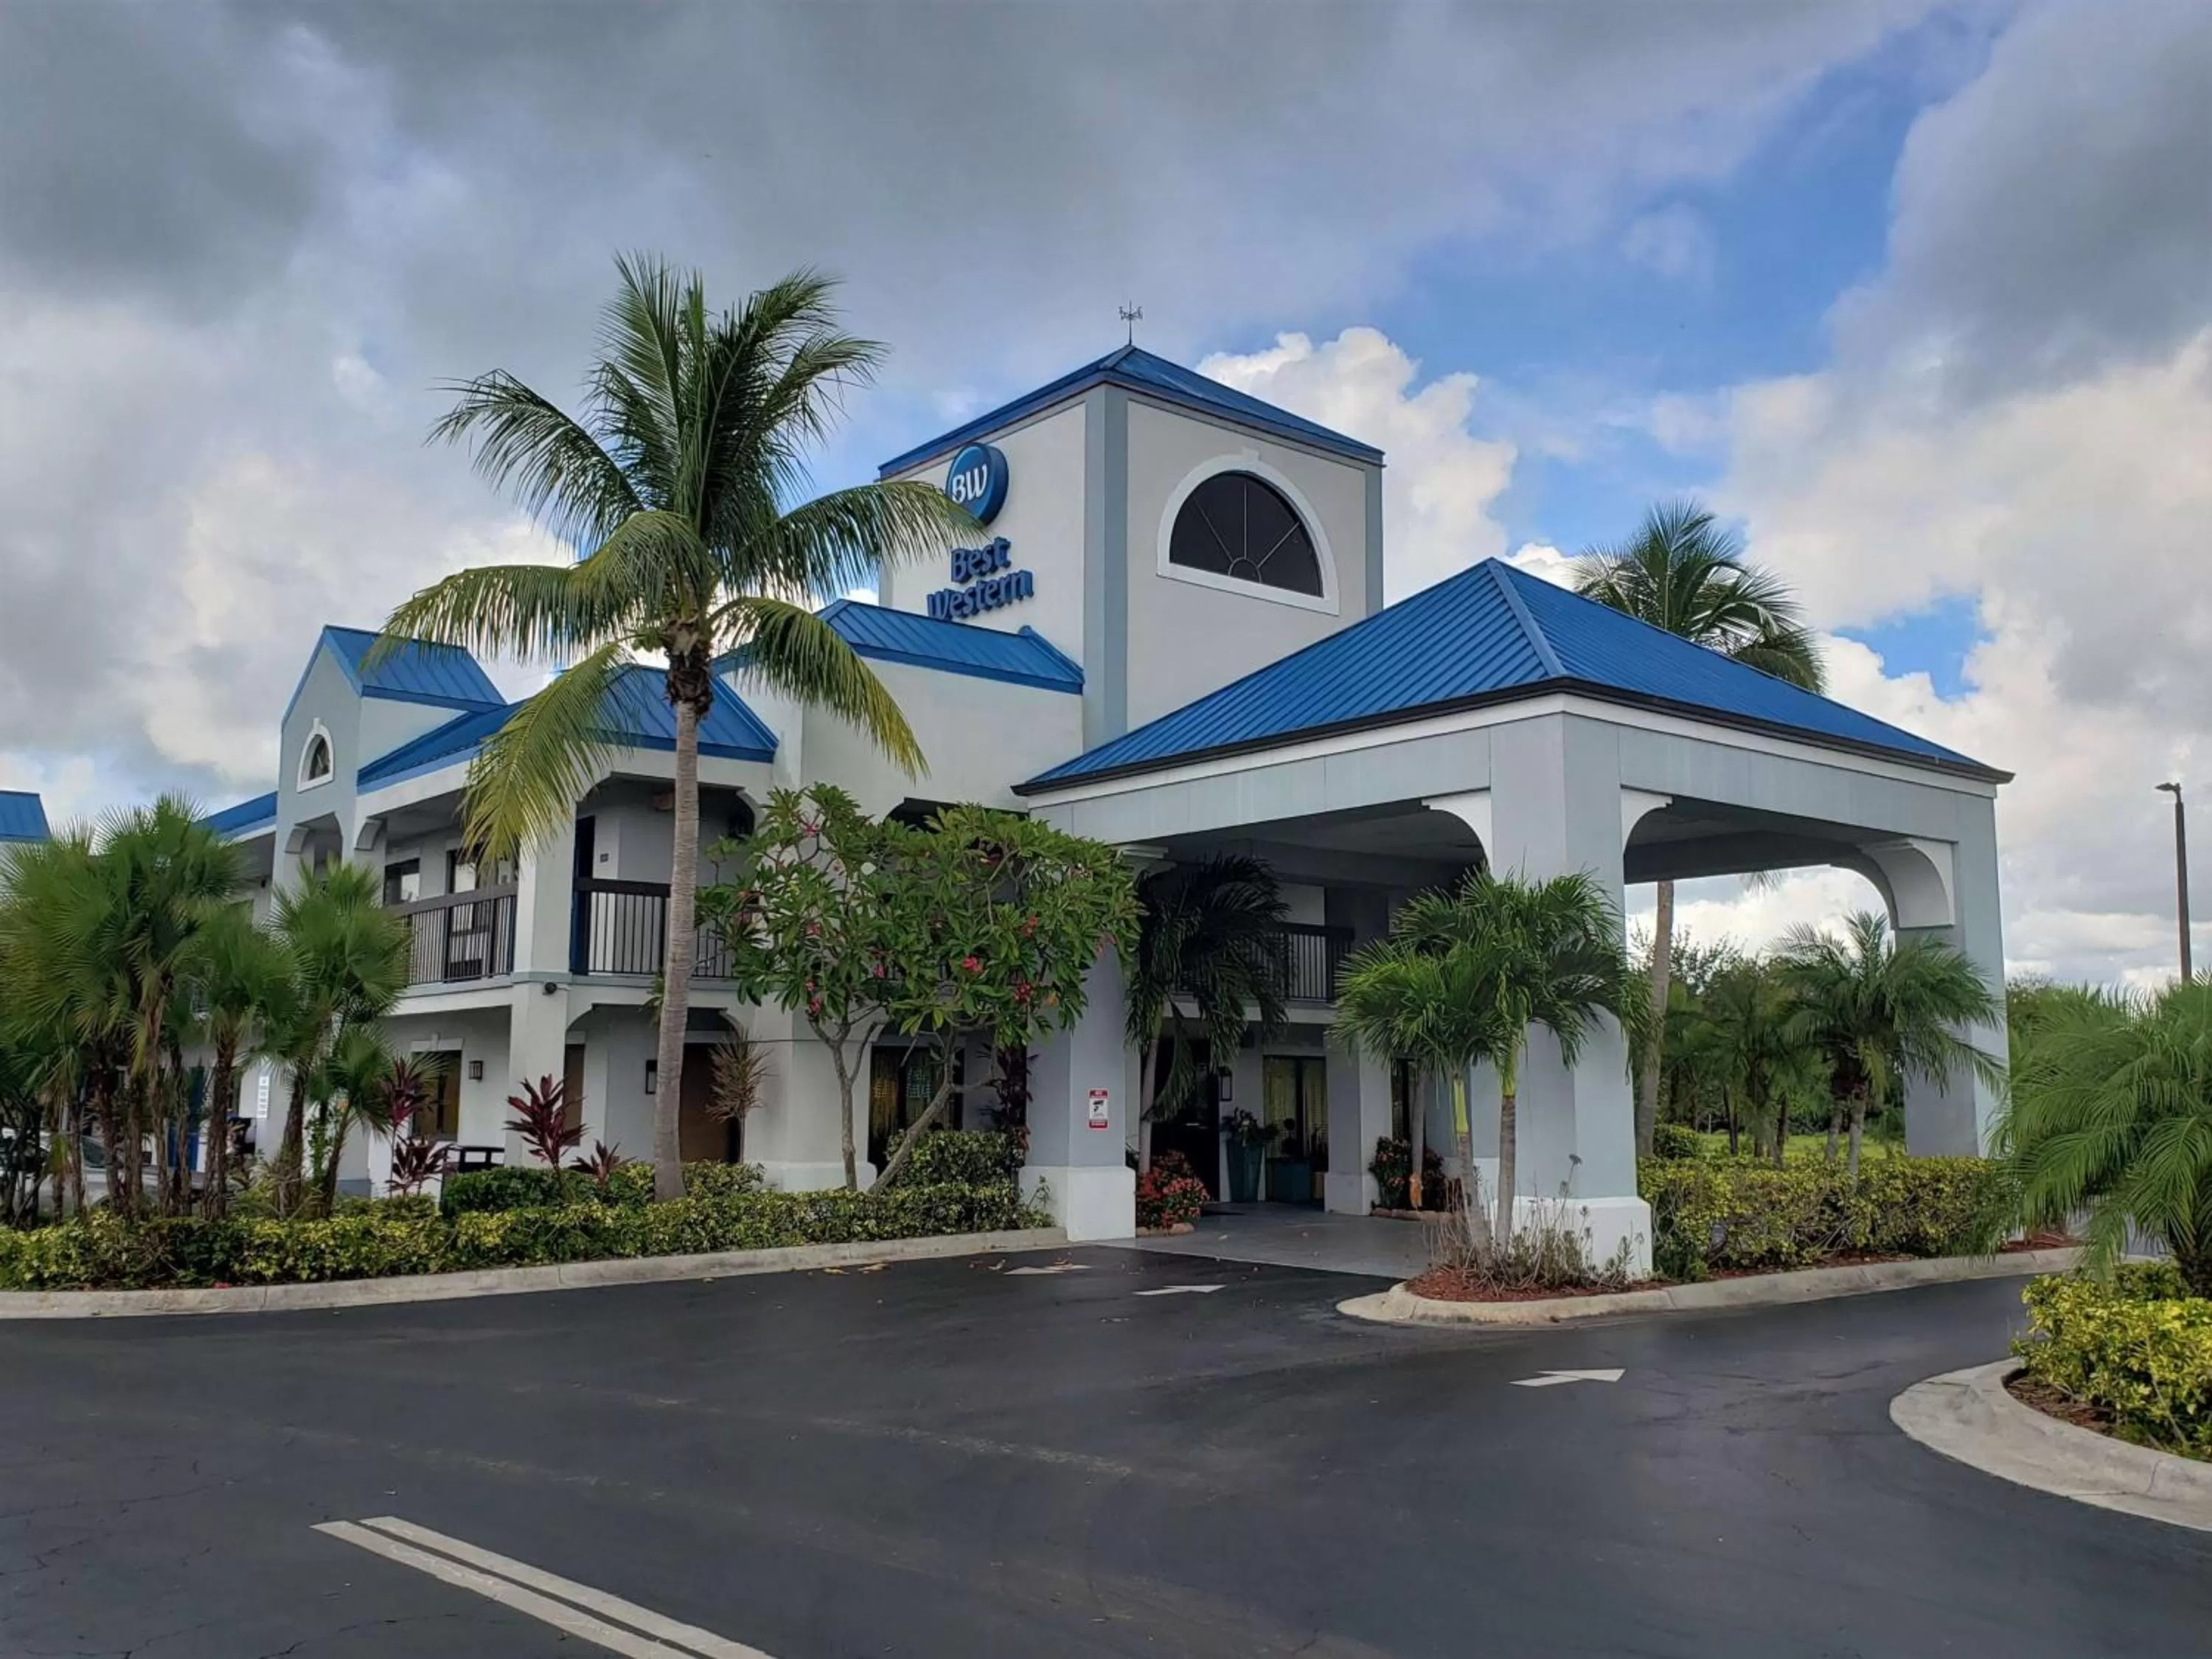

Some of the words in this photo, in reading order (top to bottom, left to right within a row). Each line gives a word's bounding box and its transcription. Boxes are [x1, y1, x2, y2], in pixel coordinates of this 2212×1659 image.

[952, 464, 987, 504] BW
[951, 537, 1011, 583] Best
[927, 570, 1034, 620] Western
